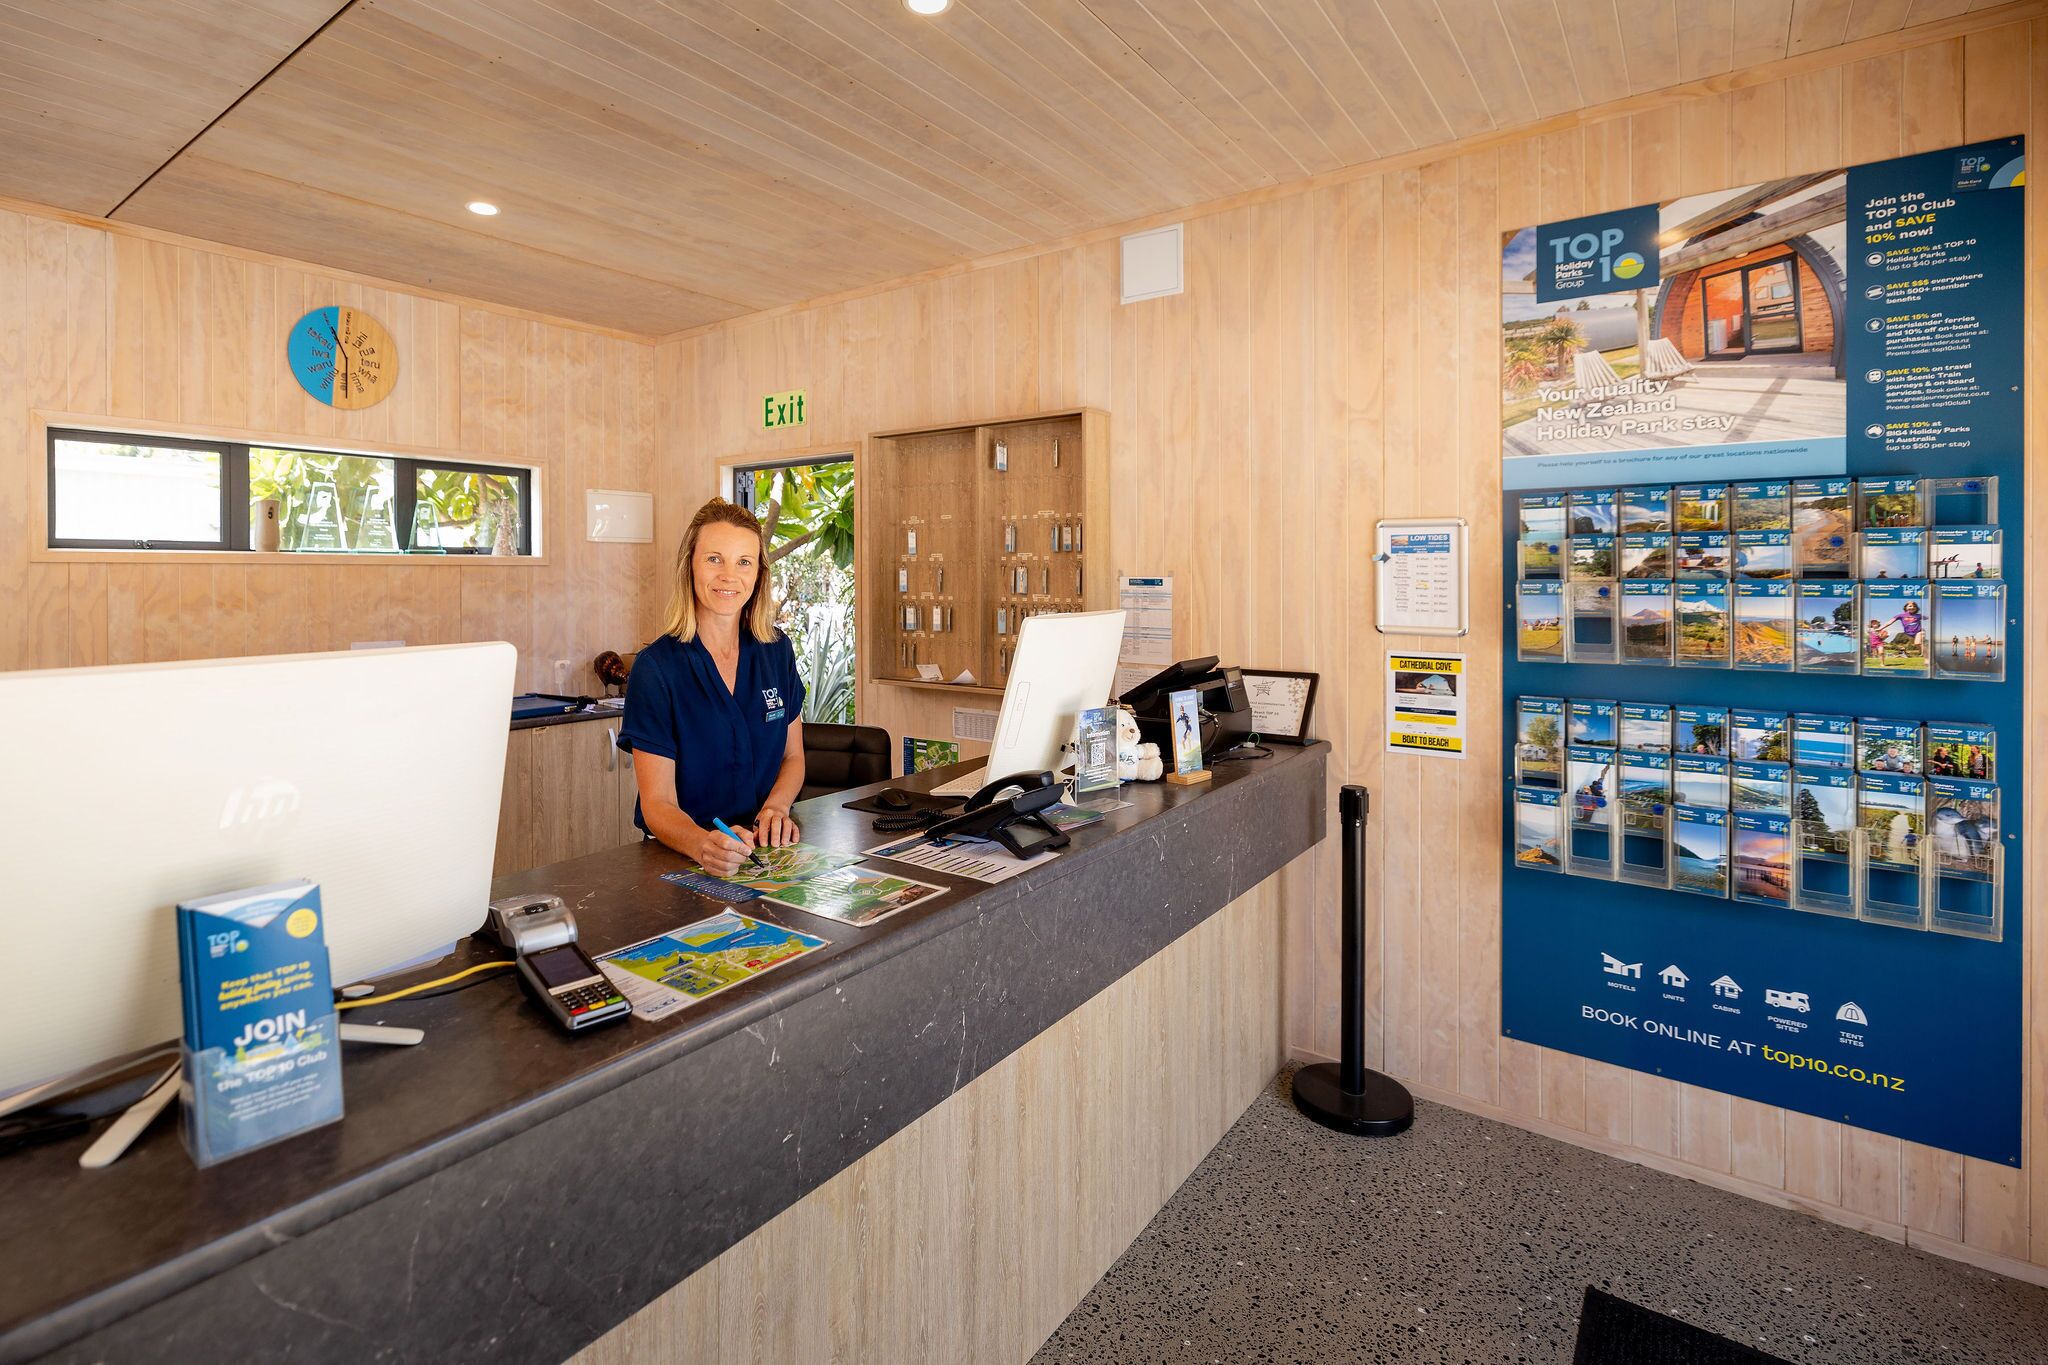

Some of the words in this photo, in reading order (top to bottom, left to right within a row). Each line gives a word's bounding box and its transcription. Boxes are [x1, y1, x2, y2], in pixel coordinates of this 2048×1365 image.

[1865, 196, 1896, 208] Join
[1901, 192, 1925, 202] the
[1866, 209, 1897, 220] TOP
[1901, 204, 1917, 213] 10
[1922, 199, 1955, 210] Club
[1865, 221, 1892, 232] and
[1896, 213, 1936, 227] SAVE
[1865, 232, 1895, 244] 10%
[1899, 226, 1933, 238] now!
[1549, 228, 1624, 263] TOP
[1886, 249, 1910, 257] SAVE
[1912, 245, 1930, 253] 10%
[1886, 254, 1917, 264] Holiday
[1913, 260, 1930, 268] $40
[1932, 258, 1947, 266] per
[1949, 254, 1970, 263] stay)
[1555, 260, 1594, 272] Holiday
[1599, 252, 1645, 282] 10
[1555, 269, 1583, 279] Parks
[1555, 280, 1584, 289] Group
[1886, 282, 1909, 290] SAVE
[1931, 273, 1983, 284] everywhere
[1932, 282, 1969, 291] member
[1886, 296, 1921, 304] benefits
[1938, 322, 1979, 331] on-board
[352, 332, 368, 349] tahi
[1886, 336, 1933, 345] purchases.
[360, 347, 375, 356] rua
[307, 360, 333, 373] waru
[350, 372, 364, 393] rima
[1886, 383, 1923, 391] journeys
[1934, 378, 1974, 386] on-board
[1538, 387, 1584, 403] Your
[1592, 379, 1668, 401] quality
[1886, 389, 1924, 397] services.
[765, 395, 803, 426] Exit
[1537, 407, 1582, 422] New
[1587, 396, 1676, 417] Zealand
[1537, 423, 1616, 441] Holiday
[1622, 417, 1676, 434] Park
[1681, 415, 1735, 431] stay
[1910, 428, 1942, 436] Holiday
[1764, 447, 1808, 455] nationwide
[1400, 660, 1434, 670] CATHEDRAL
[1436, 662, 1452, 671] COVE
[762, 688, 777, 699] TOP
[1403, 735, 1417, 743] BOAT
[1420, 736, 1427, 745] TO
[1429, 738, 1449, 747] BEACH
[208, 930, 240, 946] TOP
[221, 978, 248, 989] Keep
[250, 971, 272, 981] that
[276, 964, 297, 975] TOP
[299, 961, 310, 970] 10
[1607, 981, 1636, 992] MOTELS
[220, 992, 270, 1011] anywhere
[273, 987, 291, 998] you
[1663, 993, 1685, 1002] UNITS
[1712, 1003, 1741, 1014] CABINS
[234, 1010, 306, 1046] JOIN
[1768, 1016, 1808, 1029] POWERED
[1775, 1023, 1799, 1033] SITES
[1839, 1038, 1864, 1047] SITES
[1840, 1031, 1864, 1041] TENT
[1582, 1006, 1639, 1030] BOOK
[1643, 1020, 1720, 1049] ONLINE
[1728, 1040, 1756, 1056] AT
[1762, 1045, 1905, 1091] top10.co.nz
[217, 1078, 242, 1093] the
[245, 1065, 277, 1082] TOP
[279, 1061, 295, 1073] 10
[297, 1050, 327, 1067] Club
